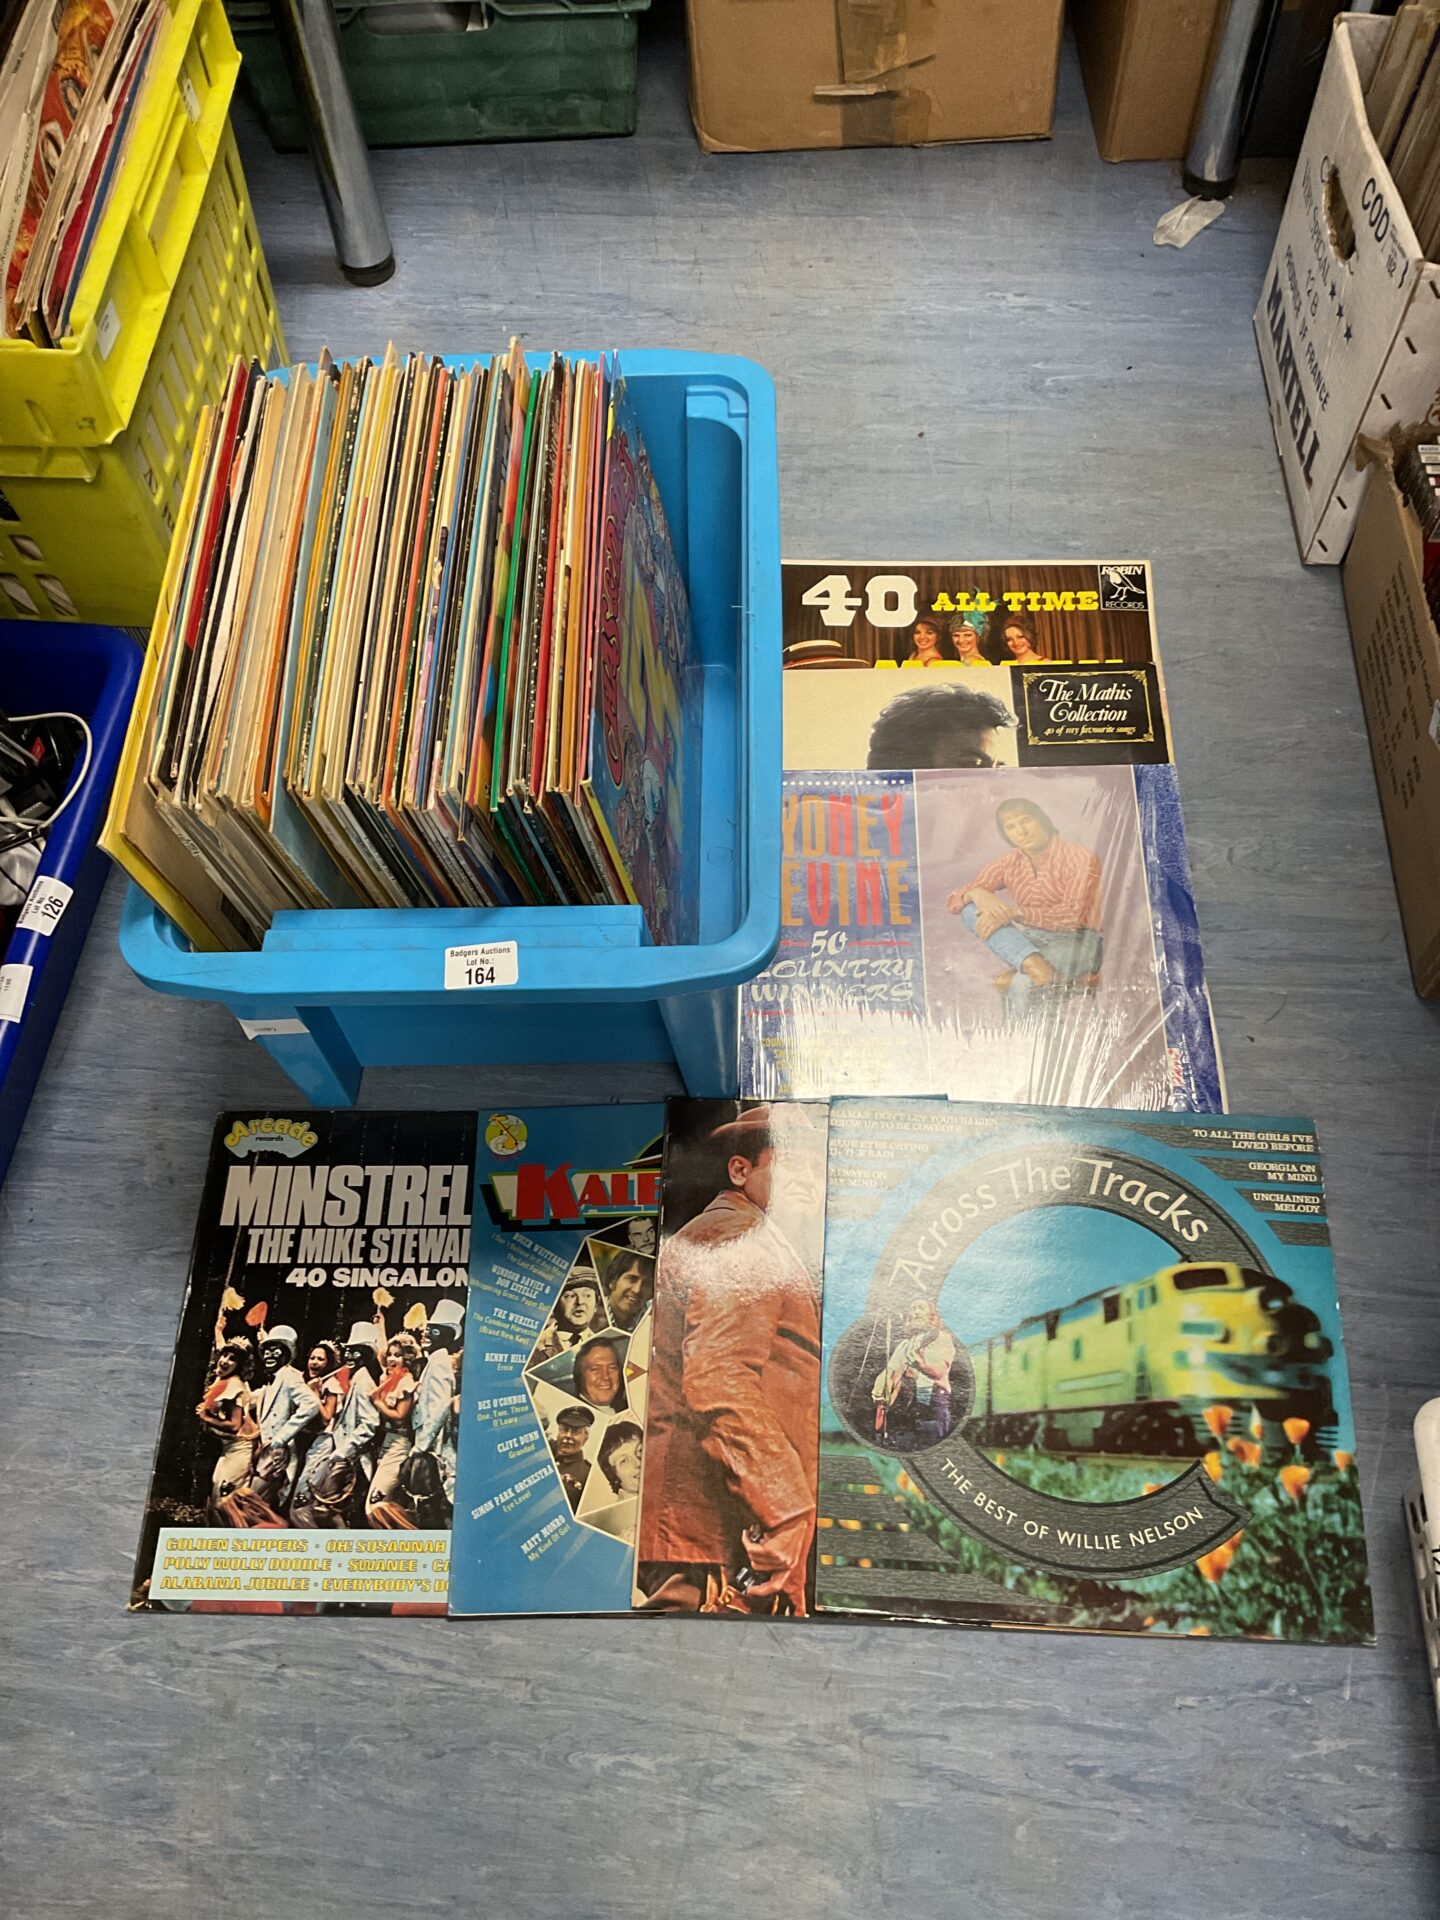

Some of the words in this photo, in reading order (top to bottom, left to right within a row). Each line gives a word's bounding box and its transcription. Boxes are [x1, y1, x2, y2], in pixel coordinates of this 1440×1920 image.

[1267, 265, 1320, 491] MARTELL
[1306, 341, 1331, 413] FRANCE
[1101, 565, 1144, 576] ROBIN
[801, 573, 918, 628] 40
[931, 591, 998, 613] ALL
[1002, 590, 1100, 612] TIME
[1105, 600, 1145, 609] RECORDS
[1039, 679, 1075, 702] The
[1074, 683, 1133, 701] Mathis
[1049, 701, 1129, 722] Collection
[1043, 726, 1054, 736] 40
[1055, 724, 1066, 736] of
[1065, 726, 1079, 735] my
[1079, 723, 1115, 736] favourite
[1115, 726, 1136, 735] songs
[41, 895, 64, 921] 126
[450, 949, 479, 958] Badgers
[480, 946, 511, 955] Auctions
[810, 930, 849, 959] 50
[466, 958, 478, 966] Lot
[464, 966, 496, 985] 164
[880, 1121, 893, 1130] TO
[895, 1123, 910, 1131] BE
[905, 1113, 928, 1123] LET
[930, 1115, 962, 1125] YOUR
[224, 1118, 319, 1148] Arcade
[255, 1134, 284, 1142] records
[1193, 1129, 1208, 1138] TO
[1209, 1130, 1232, 1139] ALL
[1232, 1131, 1256, 1141] THE
[1256, 1132, 1290, 1142] GIRLS
[1291, 1134, 1313, 1143] I'VE
[830, 1138, 858, 1147] BLUE
[1231, 1141, 1269, 1149] LOVED
[1270, 1142, 1314, 1152] BEFORE
[868, 1150, 895, 1159] RAIN
[871, 1170, 887, 1179] ON
[1248, 1162, 1298, 1172] GEORGIA
[1299, 1164, 1316, 1173] ON
[849, 1179, 878, 1188] MIND
[1267, 1172, 1284, 1181] MY
[1287, 1173, 1318, 1182] MIND
[219, 1165, 472, 1227] MINSTREL
[1252, 1192, 1320, 1204] UNCHAINED
[1274, 1203, 1320, 1213] MELODY
[887, 1178, 998, 1291] Across
[992, 1158, 1073, 1198] The
[1070, 1157, 1211, 1243] Tracks
[246, 1228, 296, 1265] THE
[297, 1228, 367, 1265] MIKE
[512, 1232, 534, 1249] ROGER
[532, 1243, 570, 1270] WHITTAKER
[285, 1268, 328, 1288] 40
[331, 1267, 469, 1288] SINGALON
[491, 1263, 520, 1282] WINDSOR
[520, 1276, 545, 1293] DAVIES
[544, 1285, 552, 1294] &
[495, 1276, 509, 1288] DON
[510, 1282, 540, 1299] ESTELLE
[493, 1307, 508, 1319] THE
[508, 1312, 540, 1330] WURZELS
[484, 1353, 508, 1363] BENNY
[510, 1353, 527, 1364] HILL
[478, 1399, 492, 1411] DES
[493, 1393, 527, 1408] O'CONNOR
[510, 1405, 529, 1414] Three
[497, 1437, 519, 1453] CLIVE
[519, 1430, 540, 1446] DUNN
[508, 1444, 536, 1459] Grandad
[471, 1499, 495, 1520] SIMON
[493, 1487, 516, 1506] PARK
[514, 1464, 555, 1493] ORCHESTRA
[502, 1501, 516, 1513] Eye
[514, 1489, 532, 1505] Level
[939, 1457, 974, 1497] THE
[972, 1491, 1020, 1527] BEST
[1022, 1518, 1050, 1541] OF
[1056, 1528, 1123, 1551] WILLIE
[1127, 1504, 1205, 1549] NELSON
[520, 1532, 542, 1554] MATT
[541, 1514, 566, 1538] MONRO
[166, 1538, 228, 1553] GOLDEN
[230, 1538, 308, 1553] SLIPPERS
[325, 1539, 354, 1554] OH!
[355, 1539, 446, 1554] SUSANNAH
[527, 1551, 540, 1562] My
[163, 1557, 213, 1572] POLLY
[213, 1557, 267, 1572] WOLLY
[269, 1557, 332, 1572] DOODLE
[347, 1558, 417, 1573] SWANEE
[160, 1577, 241, 1590] ALABAMA
[244, 1577, 309, 1591] JUBILEE
[321, 1578, 431, 1592] EVERYBODY'S
[433, 1579, 449, 1593] D
